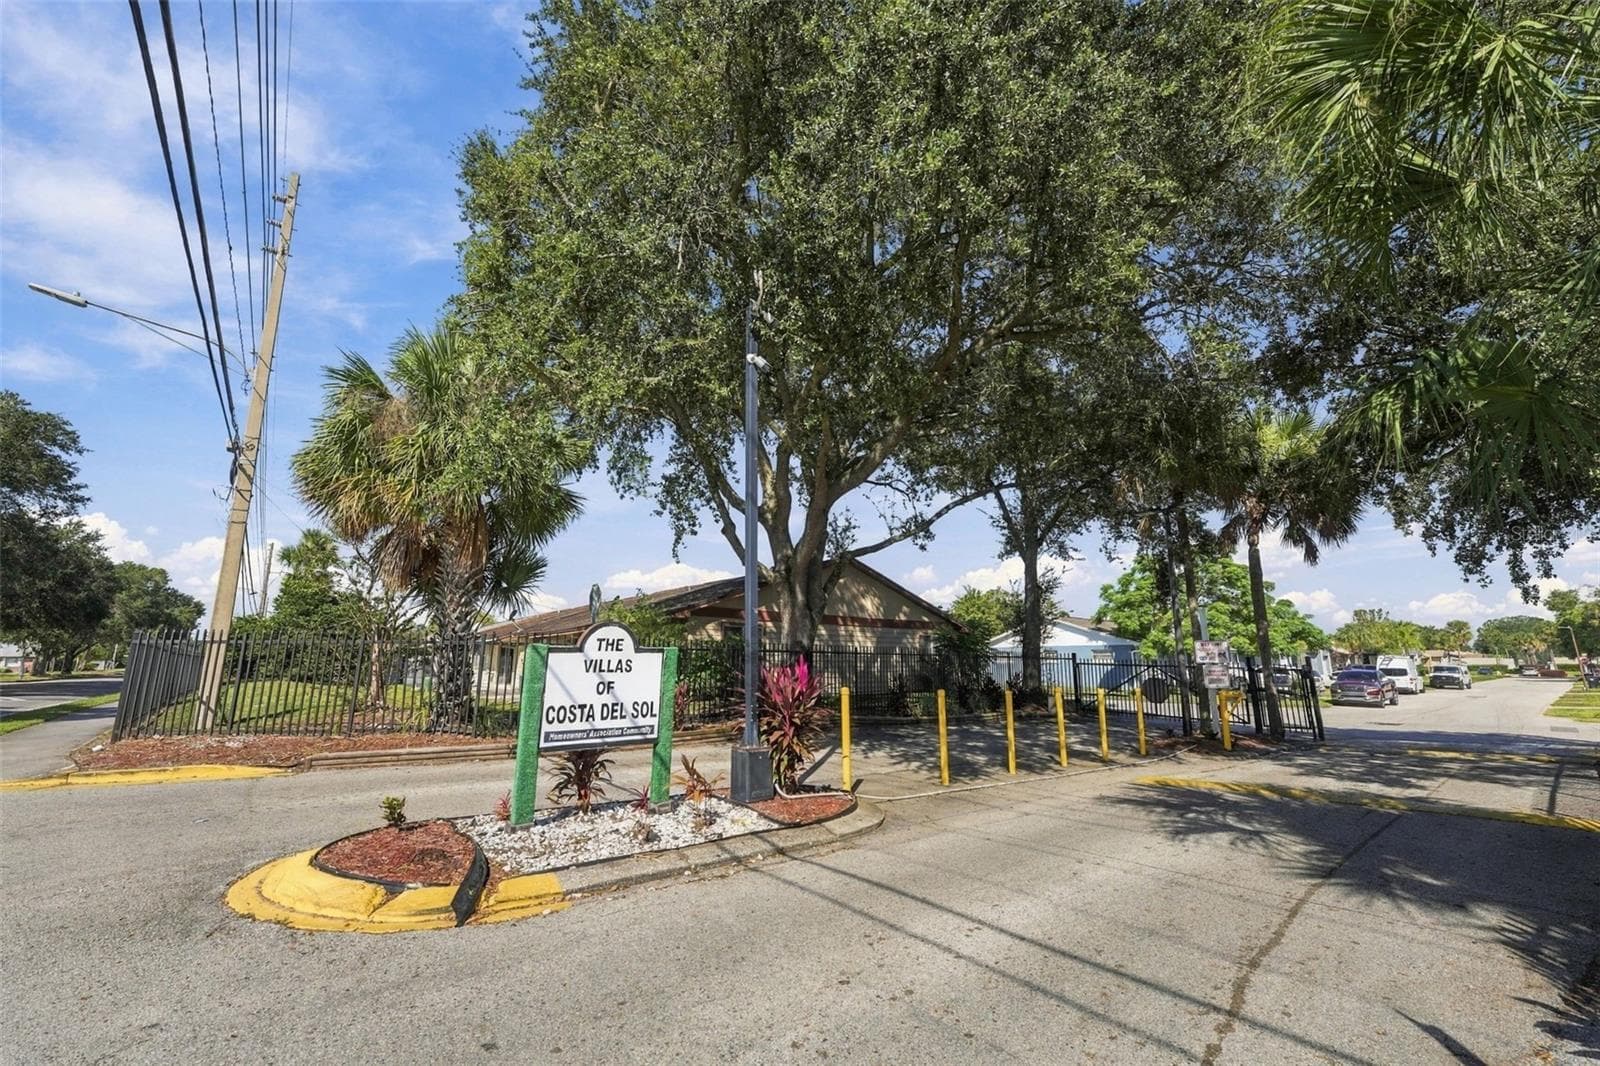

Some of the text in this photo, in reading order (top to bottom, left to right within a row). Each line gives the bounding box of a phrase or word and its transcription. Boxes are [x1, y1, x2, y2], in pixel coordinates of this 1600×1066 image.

[596, 638, 624, 652] THE
[584, 659, 633, 673] VILLAS
[596, 681, 615, 695] OF
[546, 701, 657, 725] COSTA DEL SOL
[589, 728, 621, 738] Association
